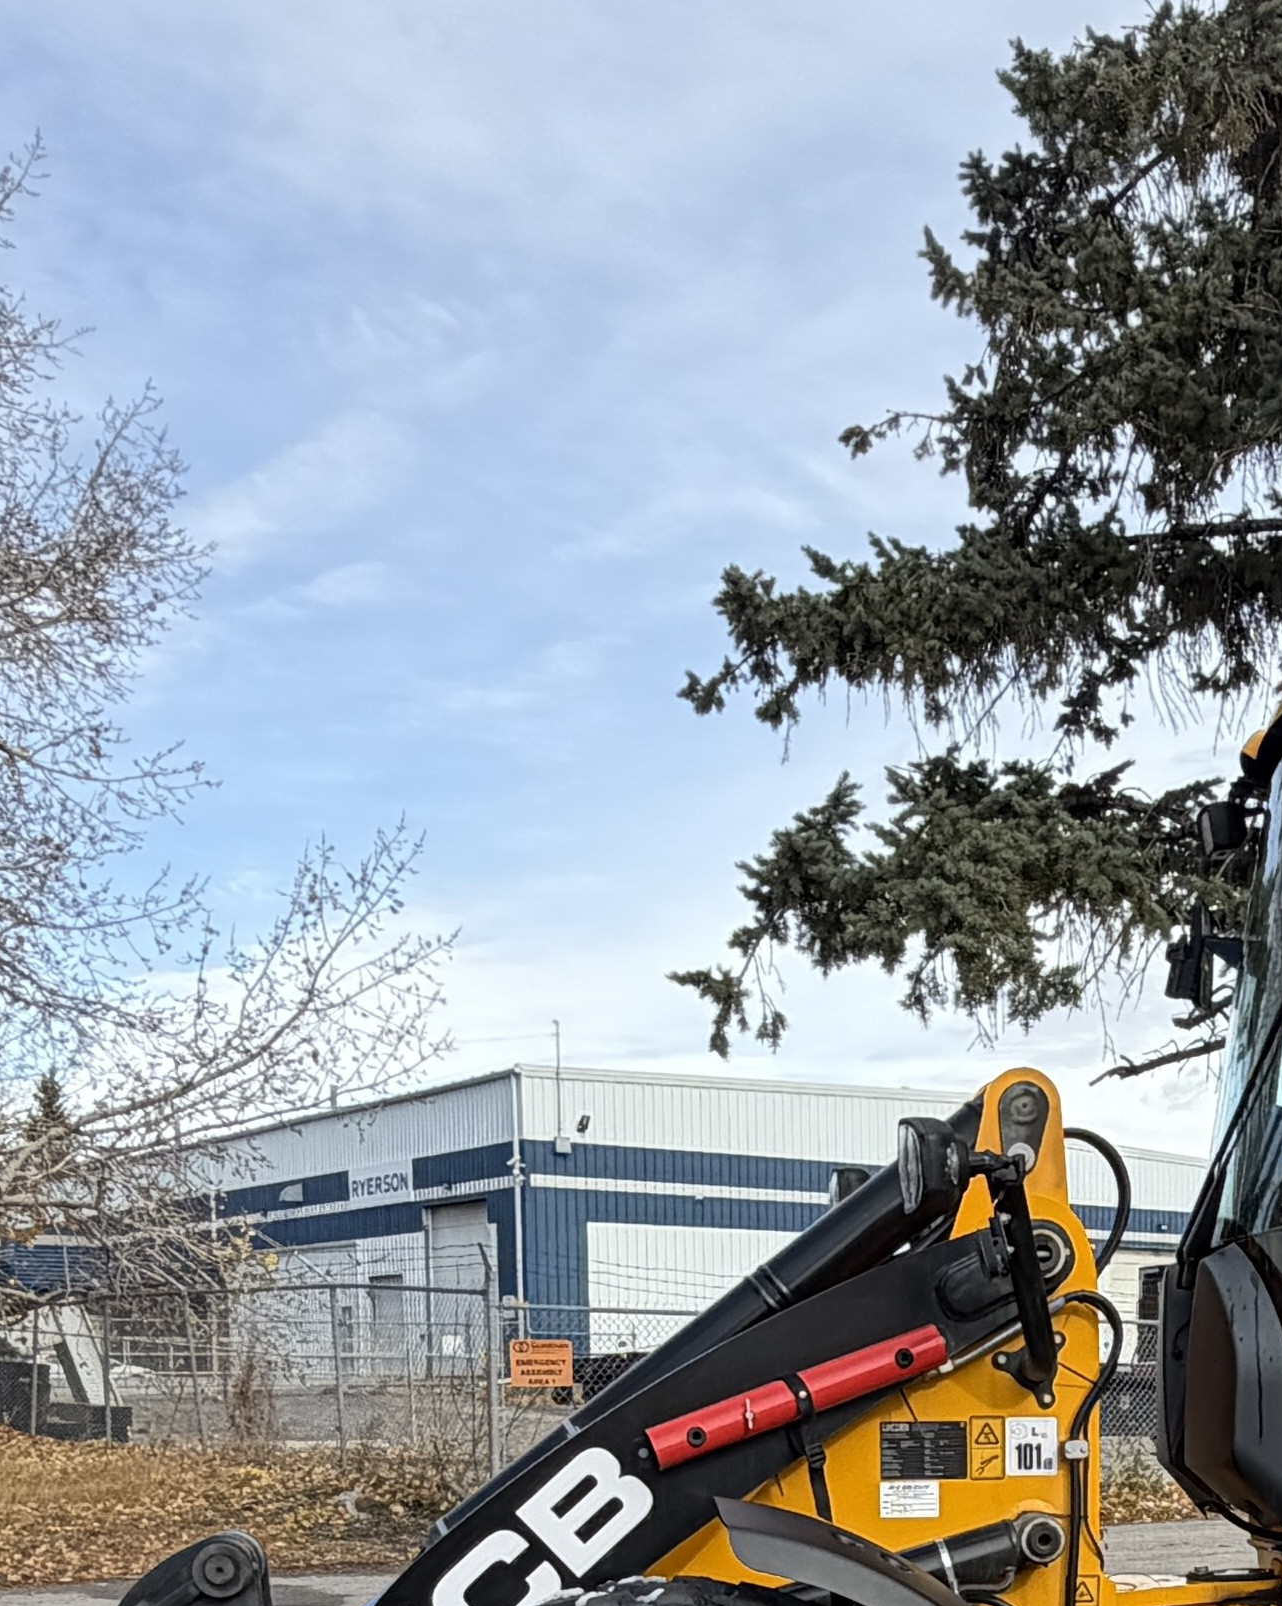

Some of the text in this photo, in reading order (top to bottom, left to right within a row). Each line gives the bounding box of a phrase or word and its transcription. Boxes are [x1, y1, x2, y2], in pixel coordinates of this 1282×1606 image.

[351, 1171, 409, 1199] RYERSON
[515, 1359, 567, 1367] EMERGENCY
[1014, 1442, 1043, 1470] 101
